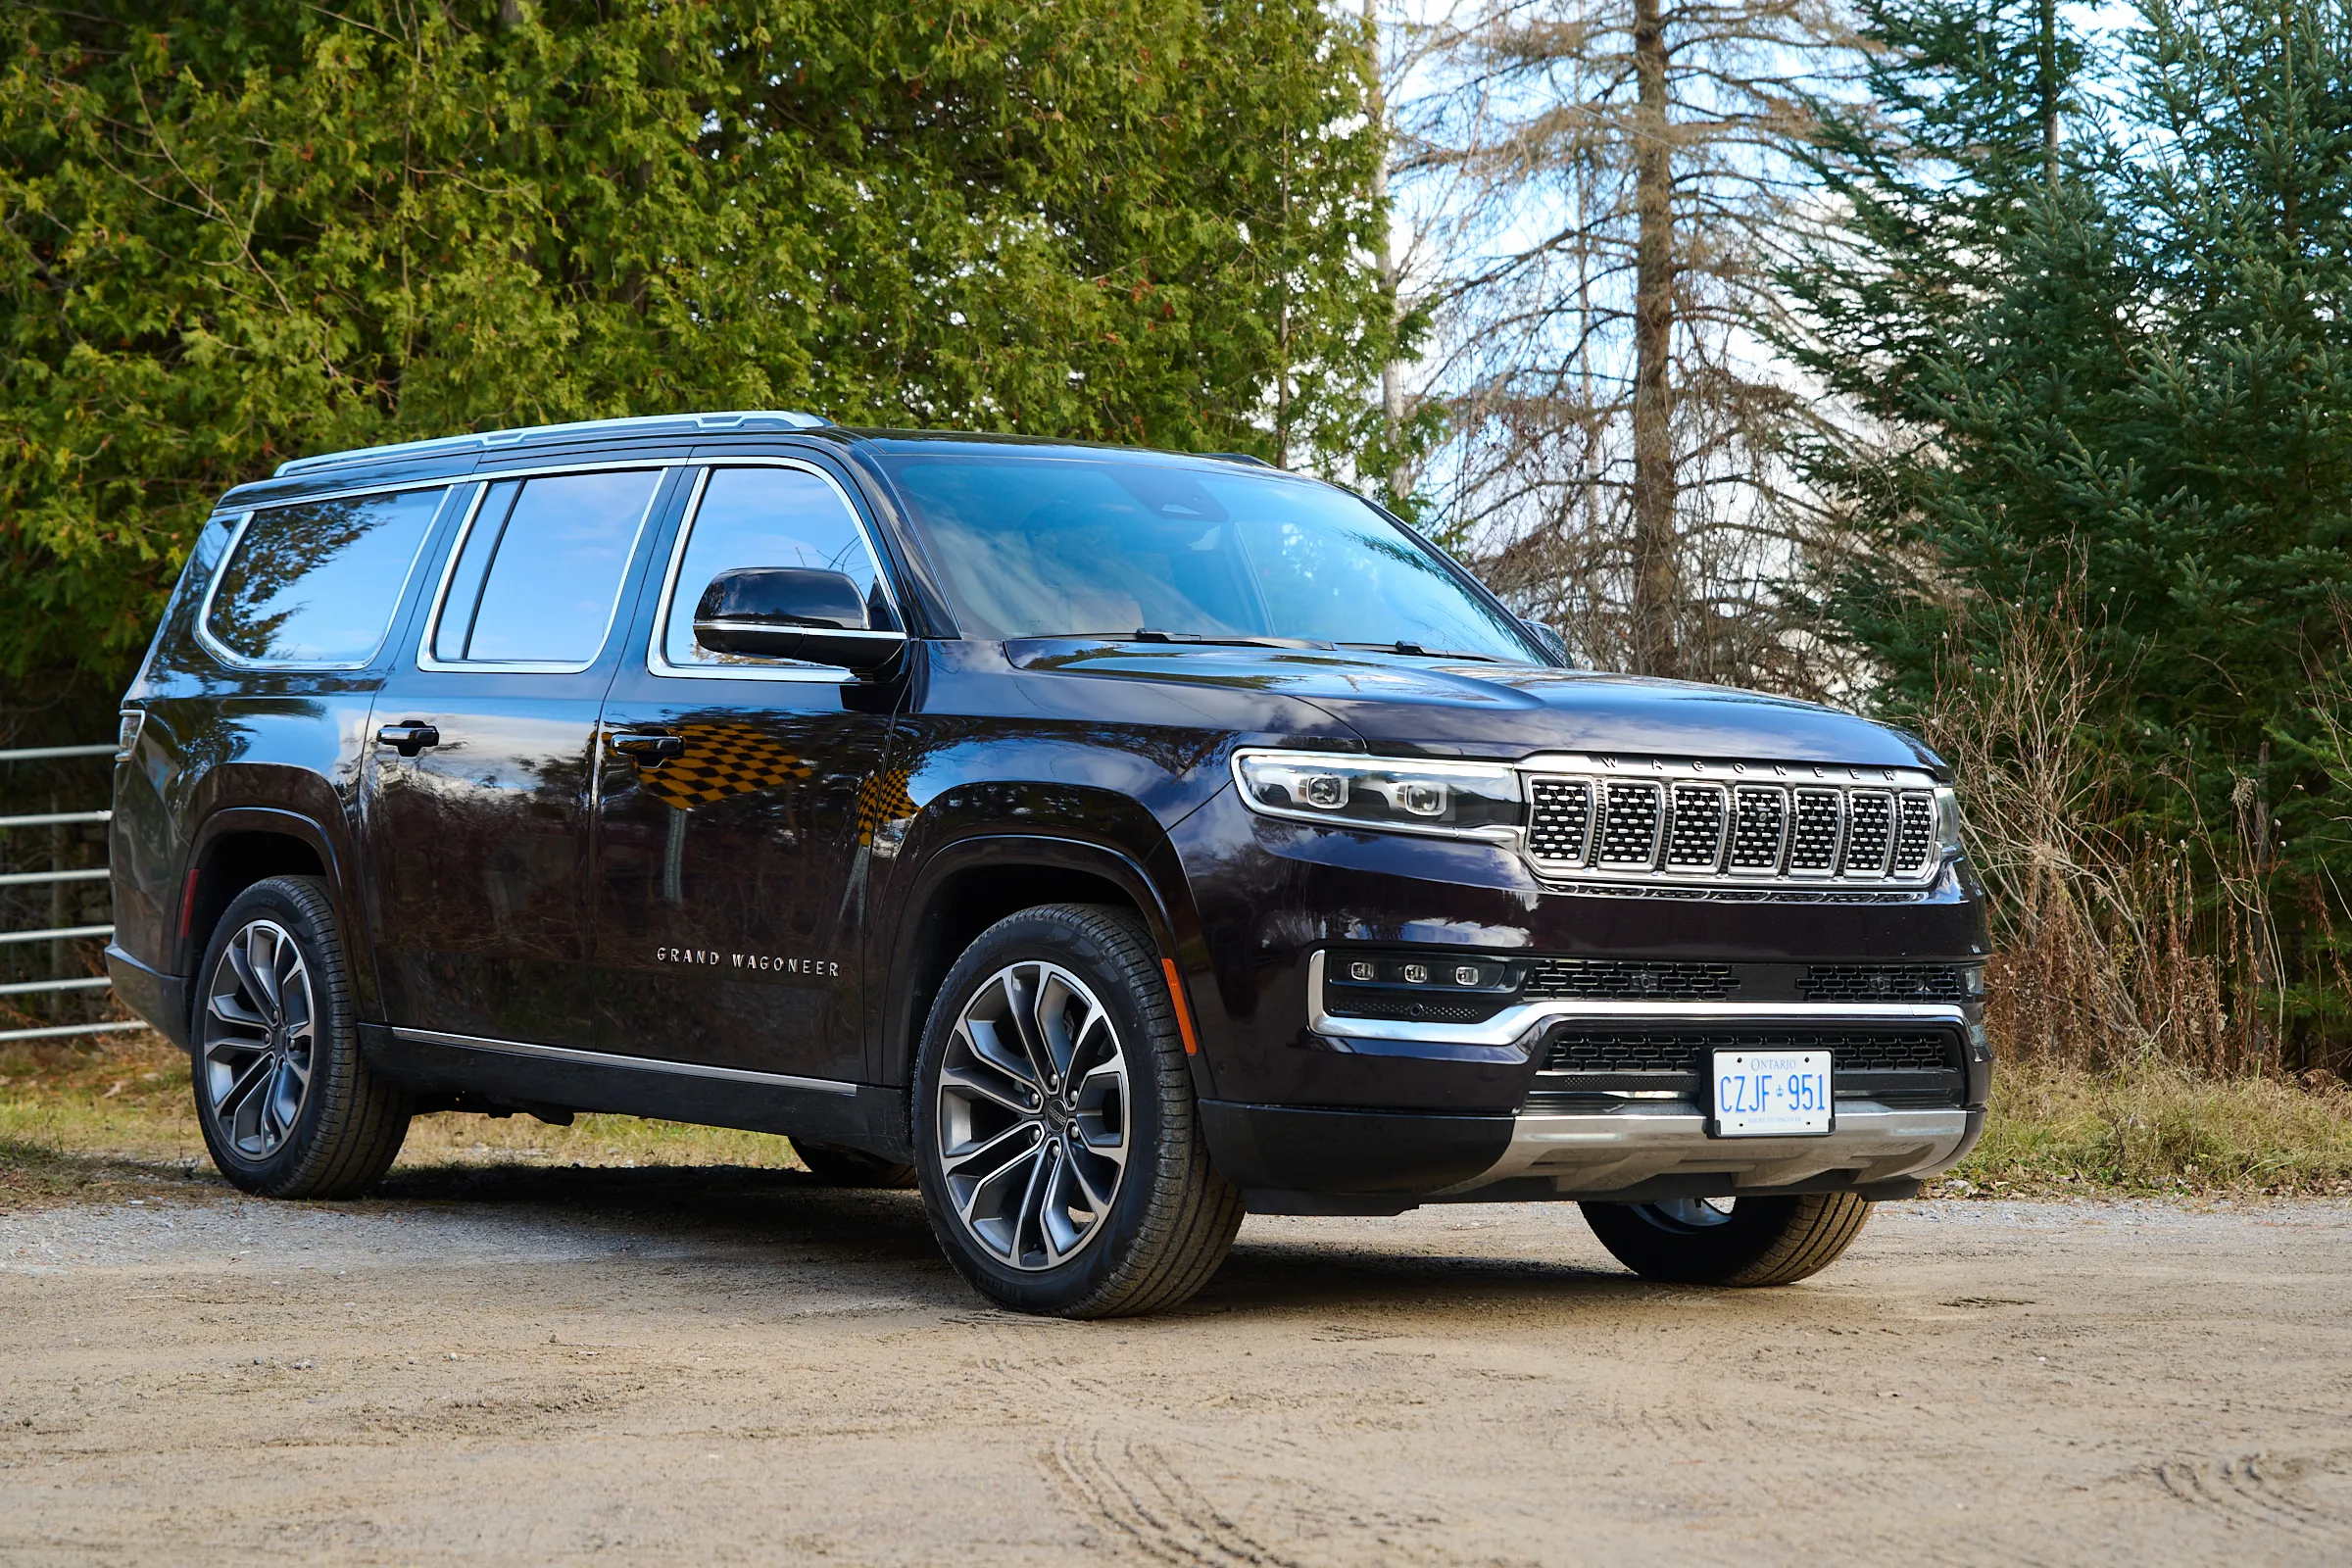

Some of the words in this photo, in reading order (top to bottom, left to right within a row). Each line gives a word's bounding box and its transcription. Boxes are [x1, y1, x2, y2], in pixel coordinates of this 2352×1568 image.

[1602, 757, 1895, 782] WAGONEER
[657, 947, 720, 965] GRAND
[732, 954, 839, 977] WAGONEER
[1750, 1058, 1796, 1071] ONTARIO
[1720, 1075, 1773, 1112] CZJF
[1788, 1074, 1826, 1110] 951
